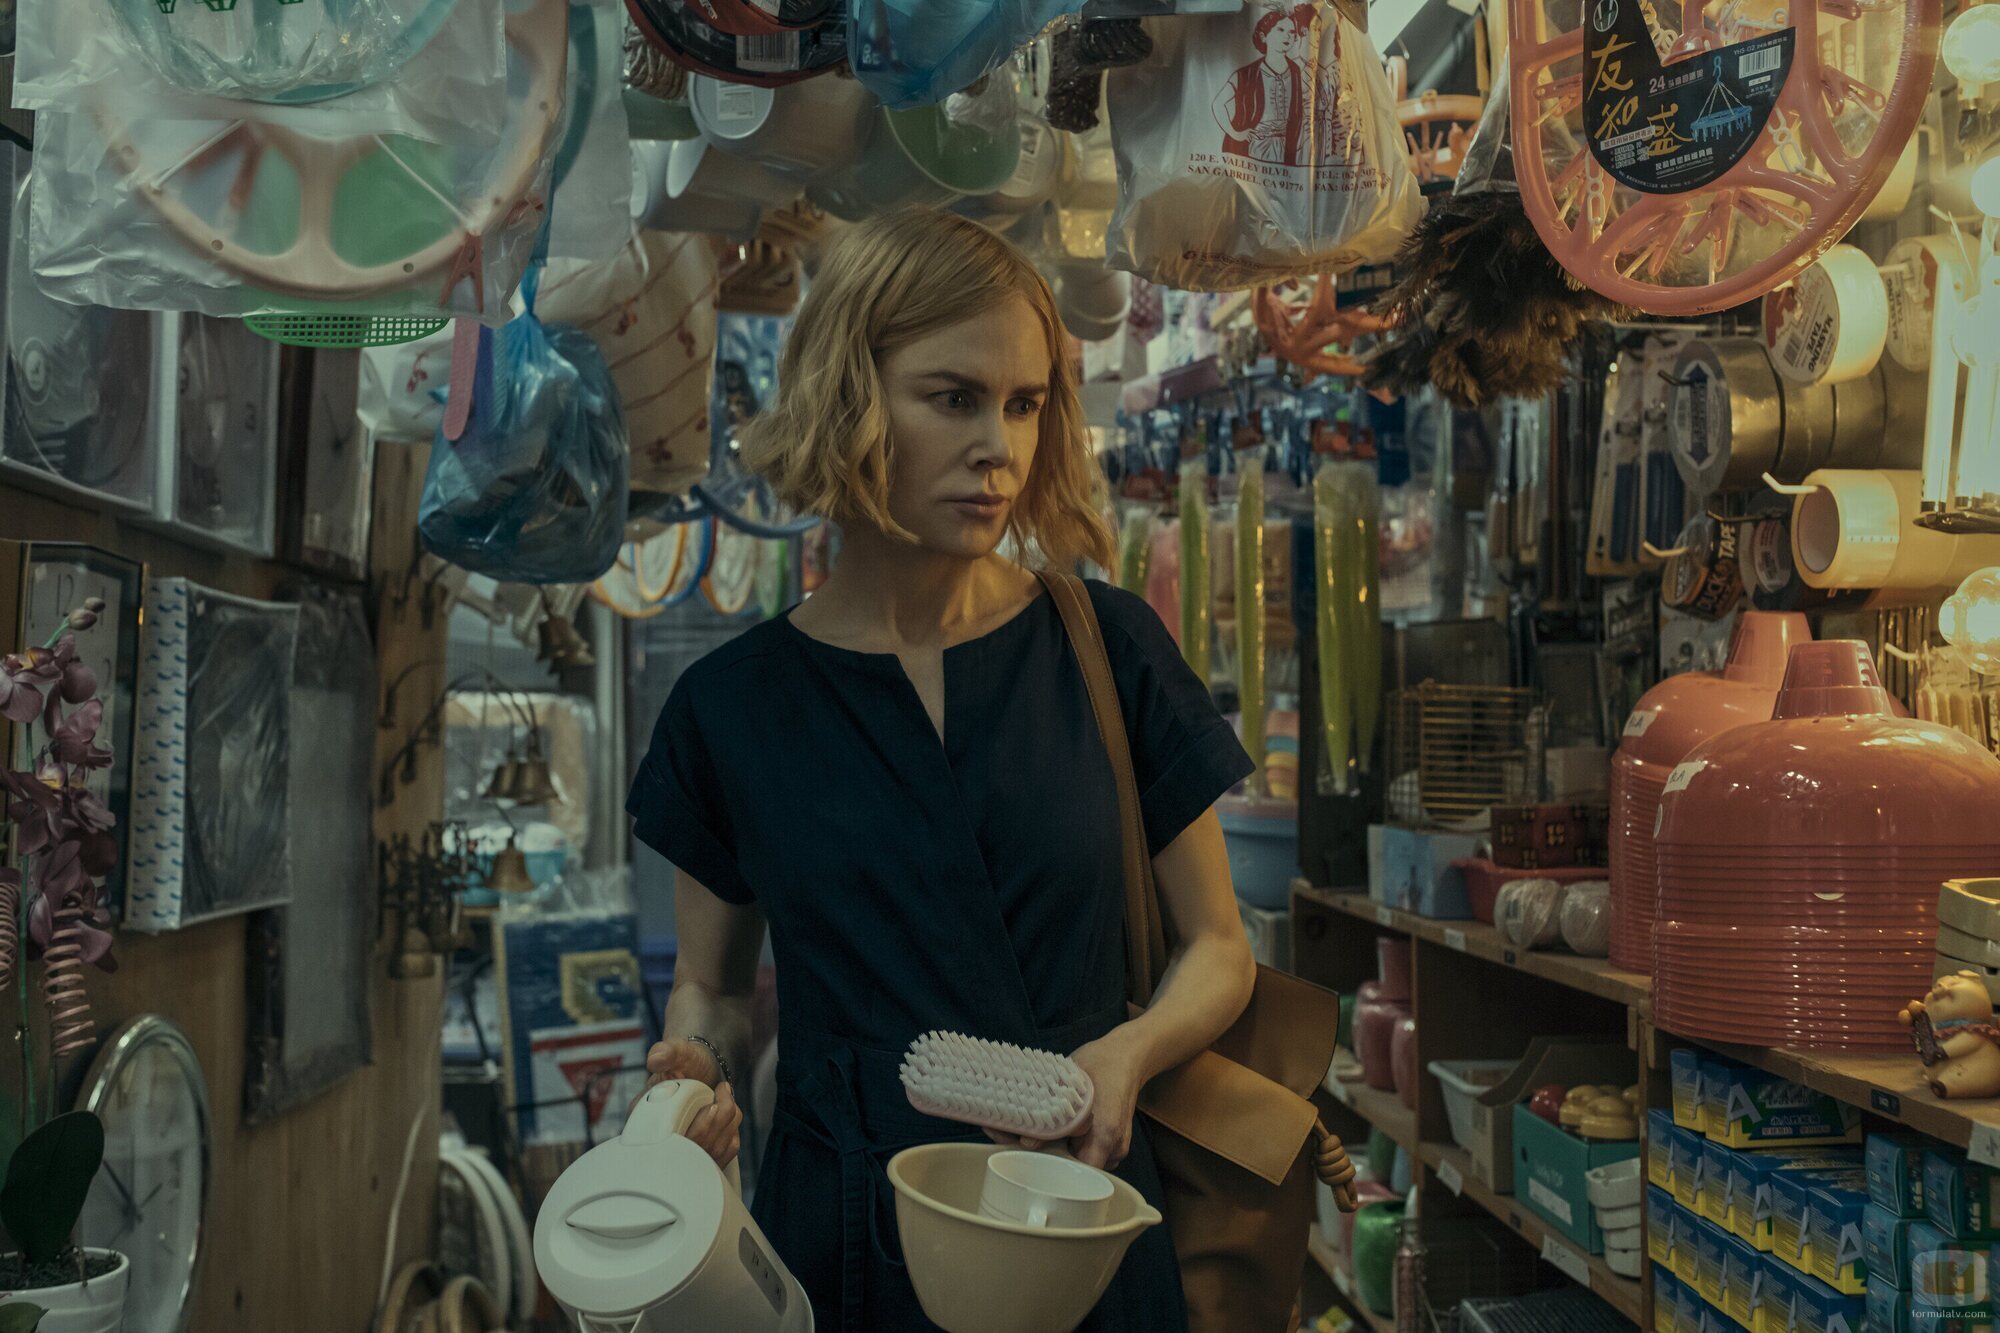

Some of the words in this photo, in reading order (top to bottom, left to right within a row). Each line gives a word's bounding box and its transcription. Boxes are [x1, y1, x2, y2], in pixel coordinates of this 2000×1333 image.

[1649, 75, 1666, 94] 24
[1187, 165, 1211, 175] SAN
[1263, 178, 1277, 188] CA
[1279, 181, 1304, 192] 91776
[1189, 153, 1206, 162] 120
[1209, 154, 1219, 163] E.
[1222, 156, 1259, 172] VALLEY
[1262, 167, 1292, 178] BLVD.
[1316, 171, 1338, 179] TEL:
[1314, 183, 1338, 192] FAX:
[1806, 322, 1822, 353] TAPE
[1808, 313, 1833, 373] MASKING
[1718, 522, 1736, 559] TAPE
